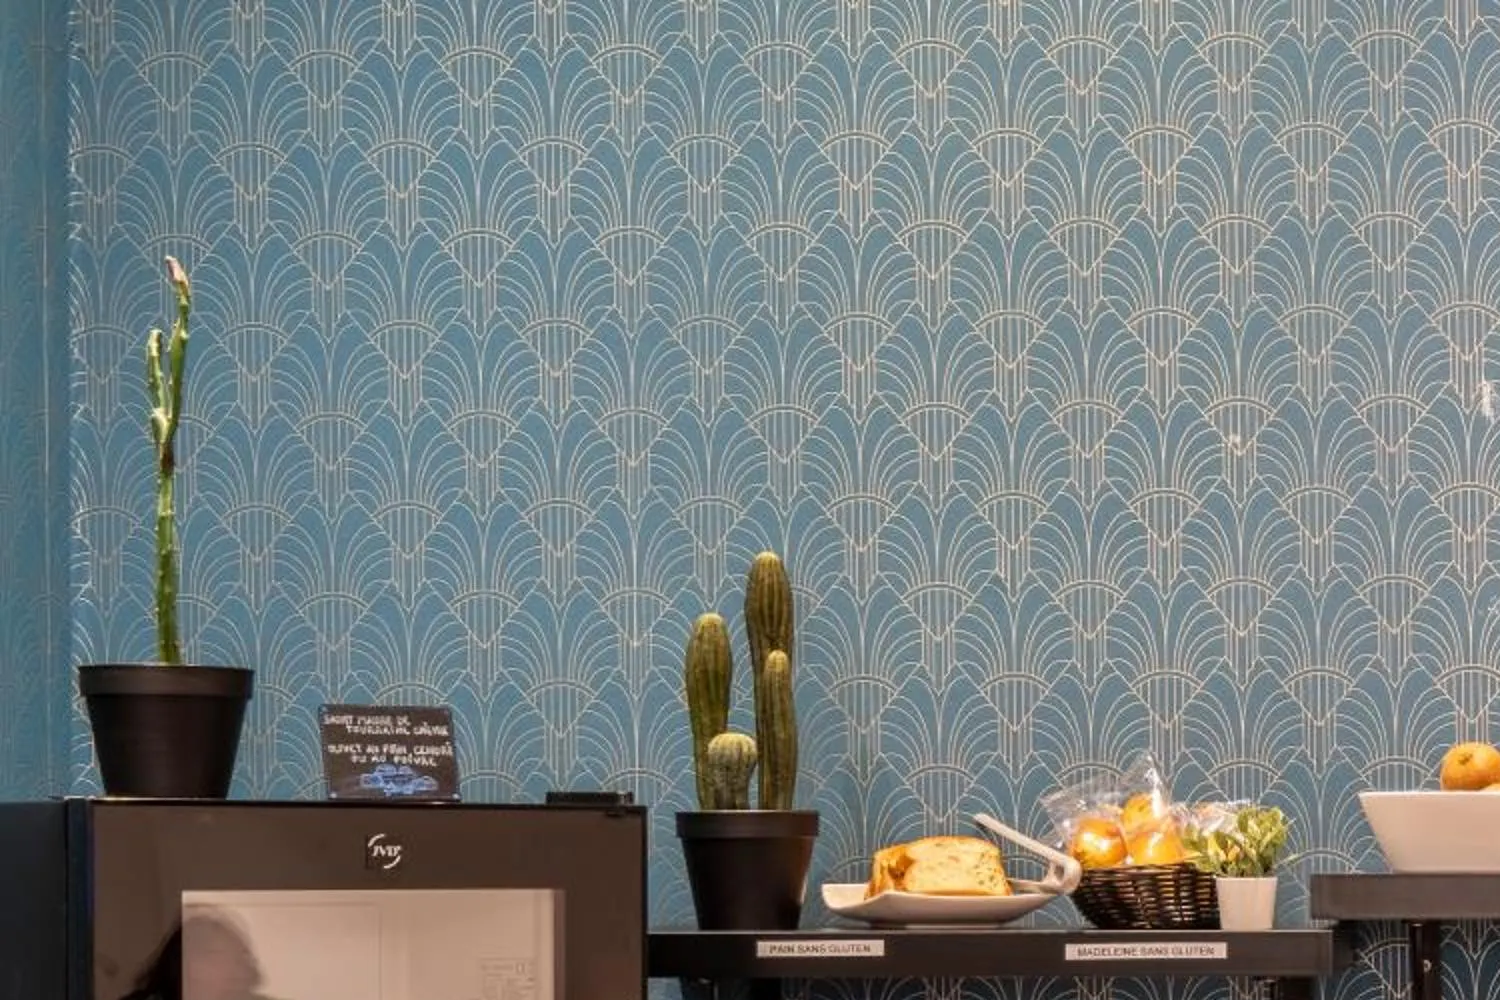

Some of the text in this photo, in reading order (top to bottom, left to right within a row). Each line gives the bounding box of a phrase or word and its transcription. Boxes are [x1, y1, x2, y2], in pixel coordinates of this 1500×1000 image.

[768, 943, 871, 955] PAIN SANS GLUTEN
[1077, 946, 1215, 957] MADELEINE SANS GLUTEN
